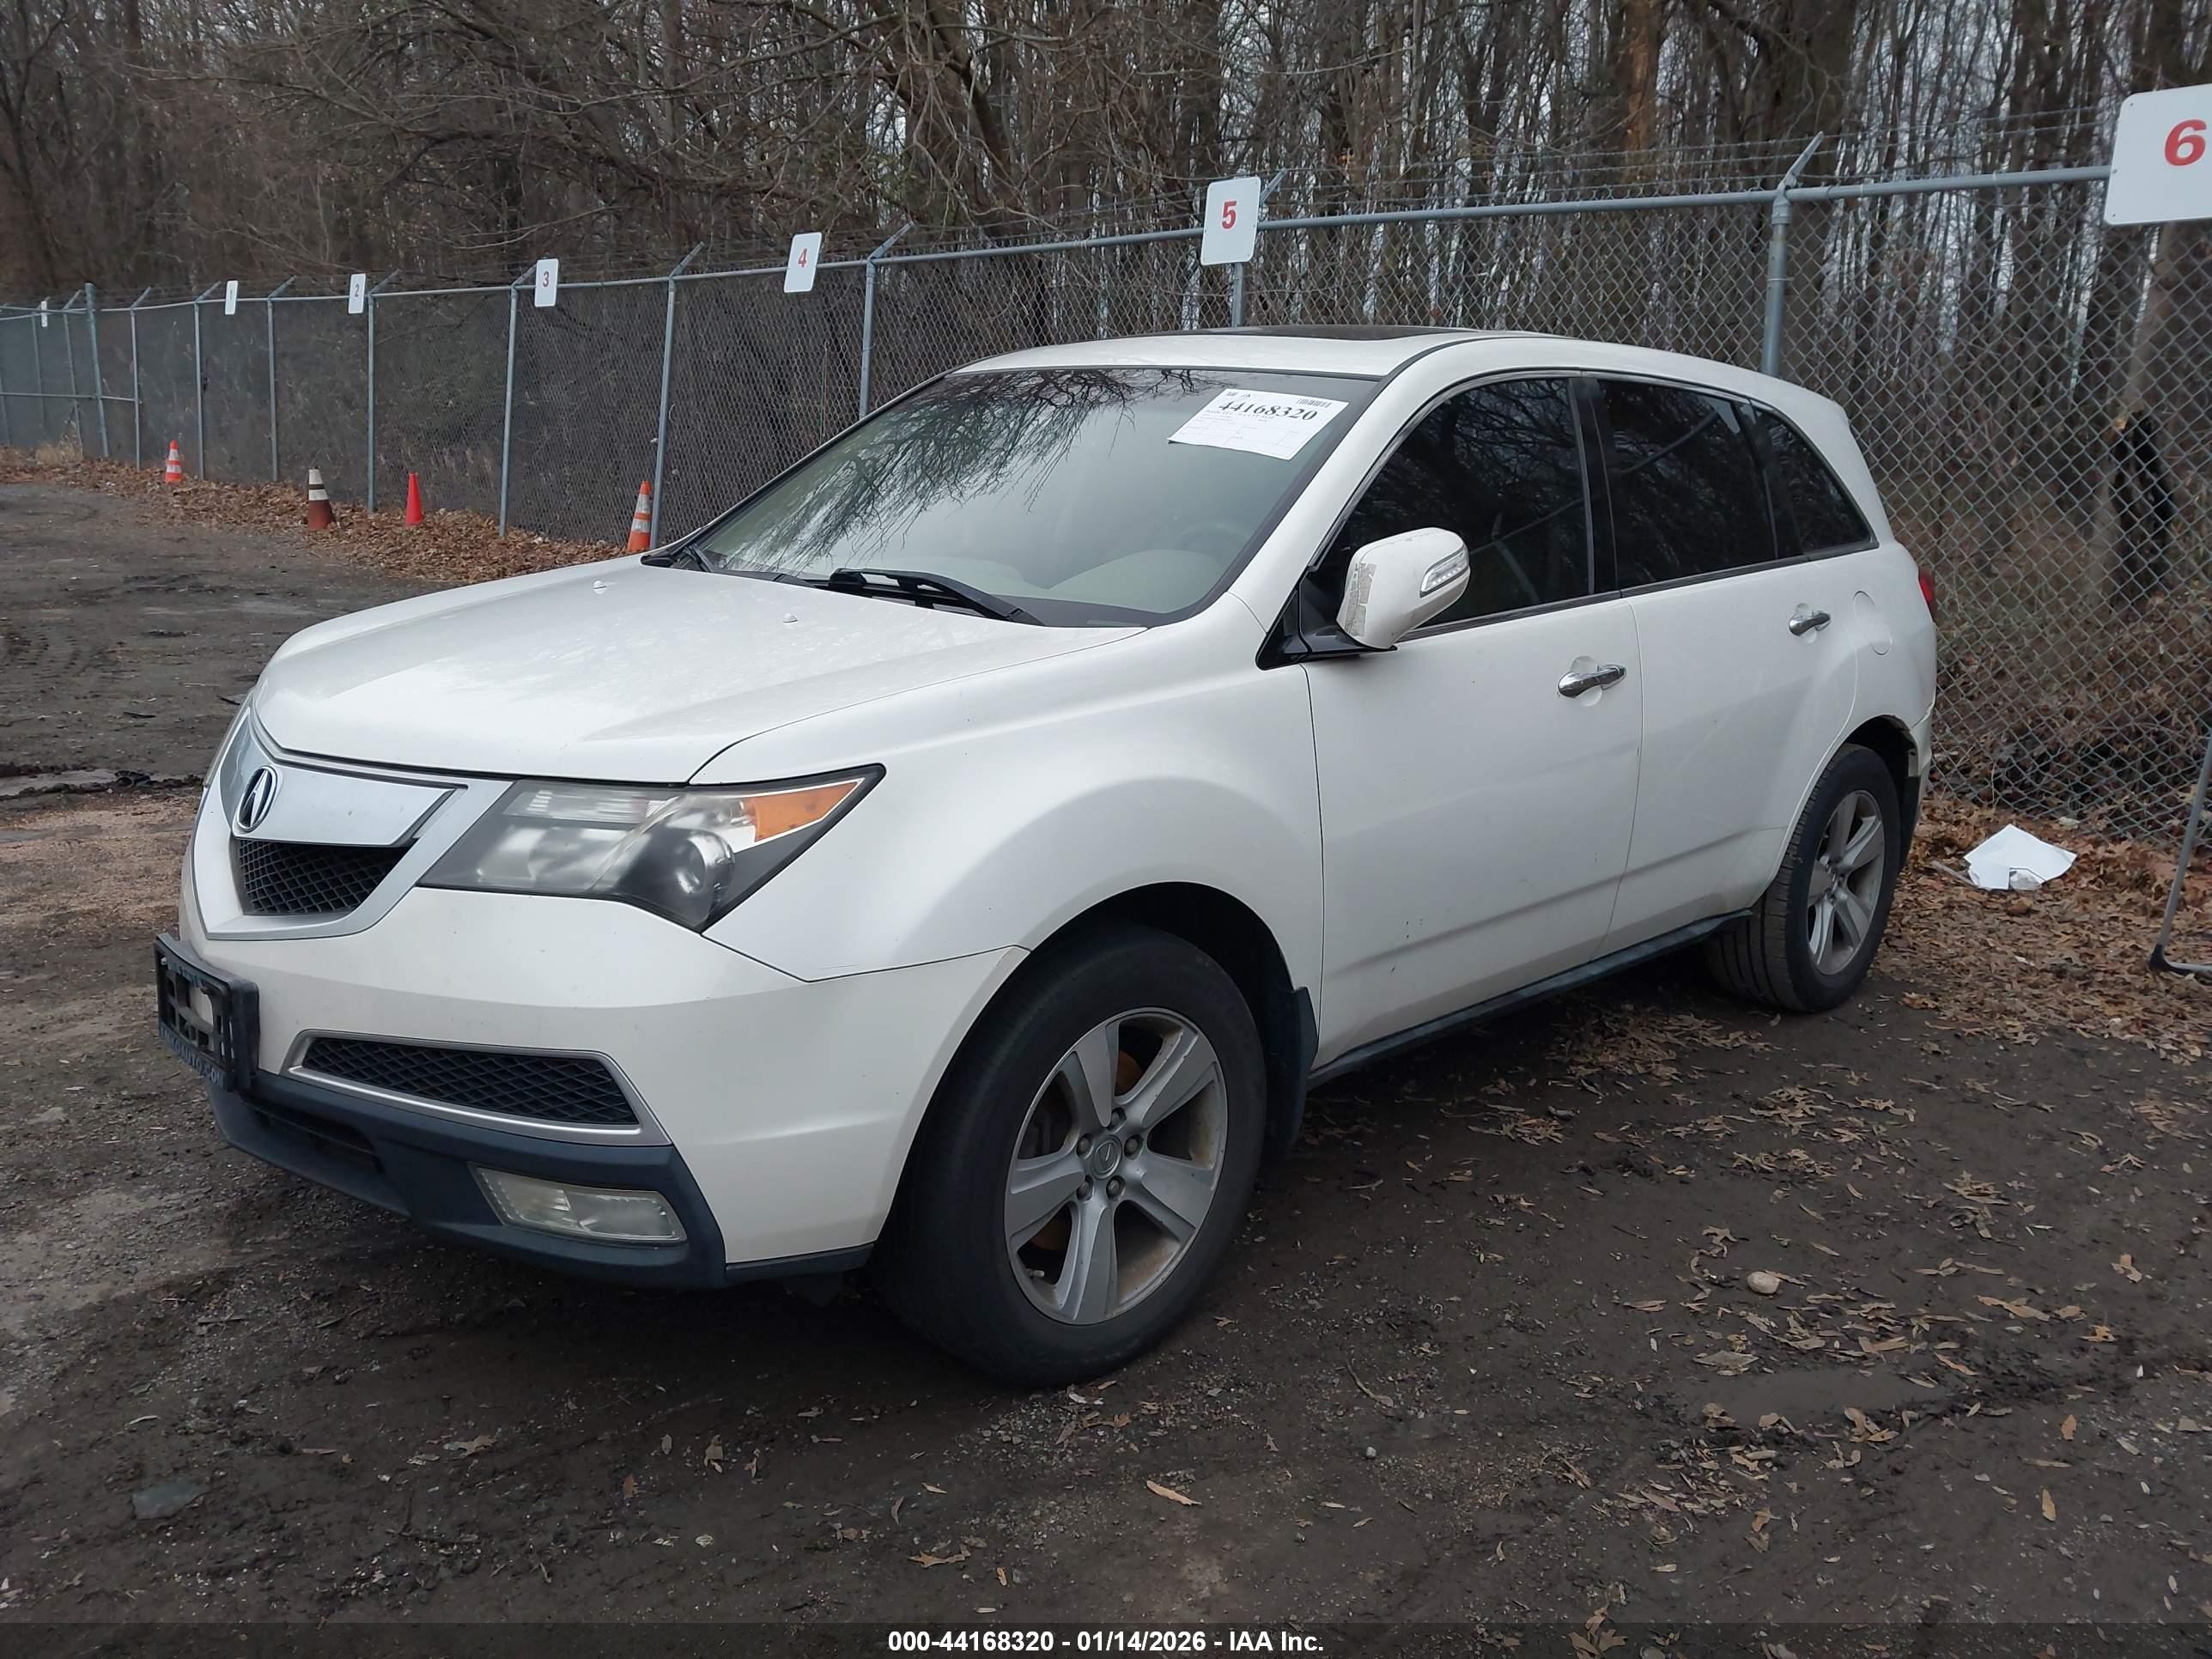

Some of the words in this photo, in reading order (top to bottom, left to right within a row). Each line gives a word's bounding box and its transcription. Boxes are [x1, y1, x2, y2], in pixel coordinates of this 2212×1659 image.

[2165, 118, 2207, 166] 6
[1222, 200, 1237, 229] 5
[798, 248, 807, 267] 4
[543, 270, 550, 288] 3
[354, 283, 360, 297] 2
[1219, 401, 1317, 420] 44168320
